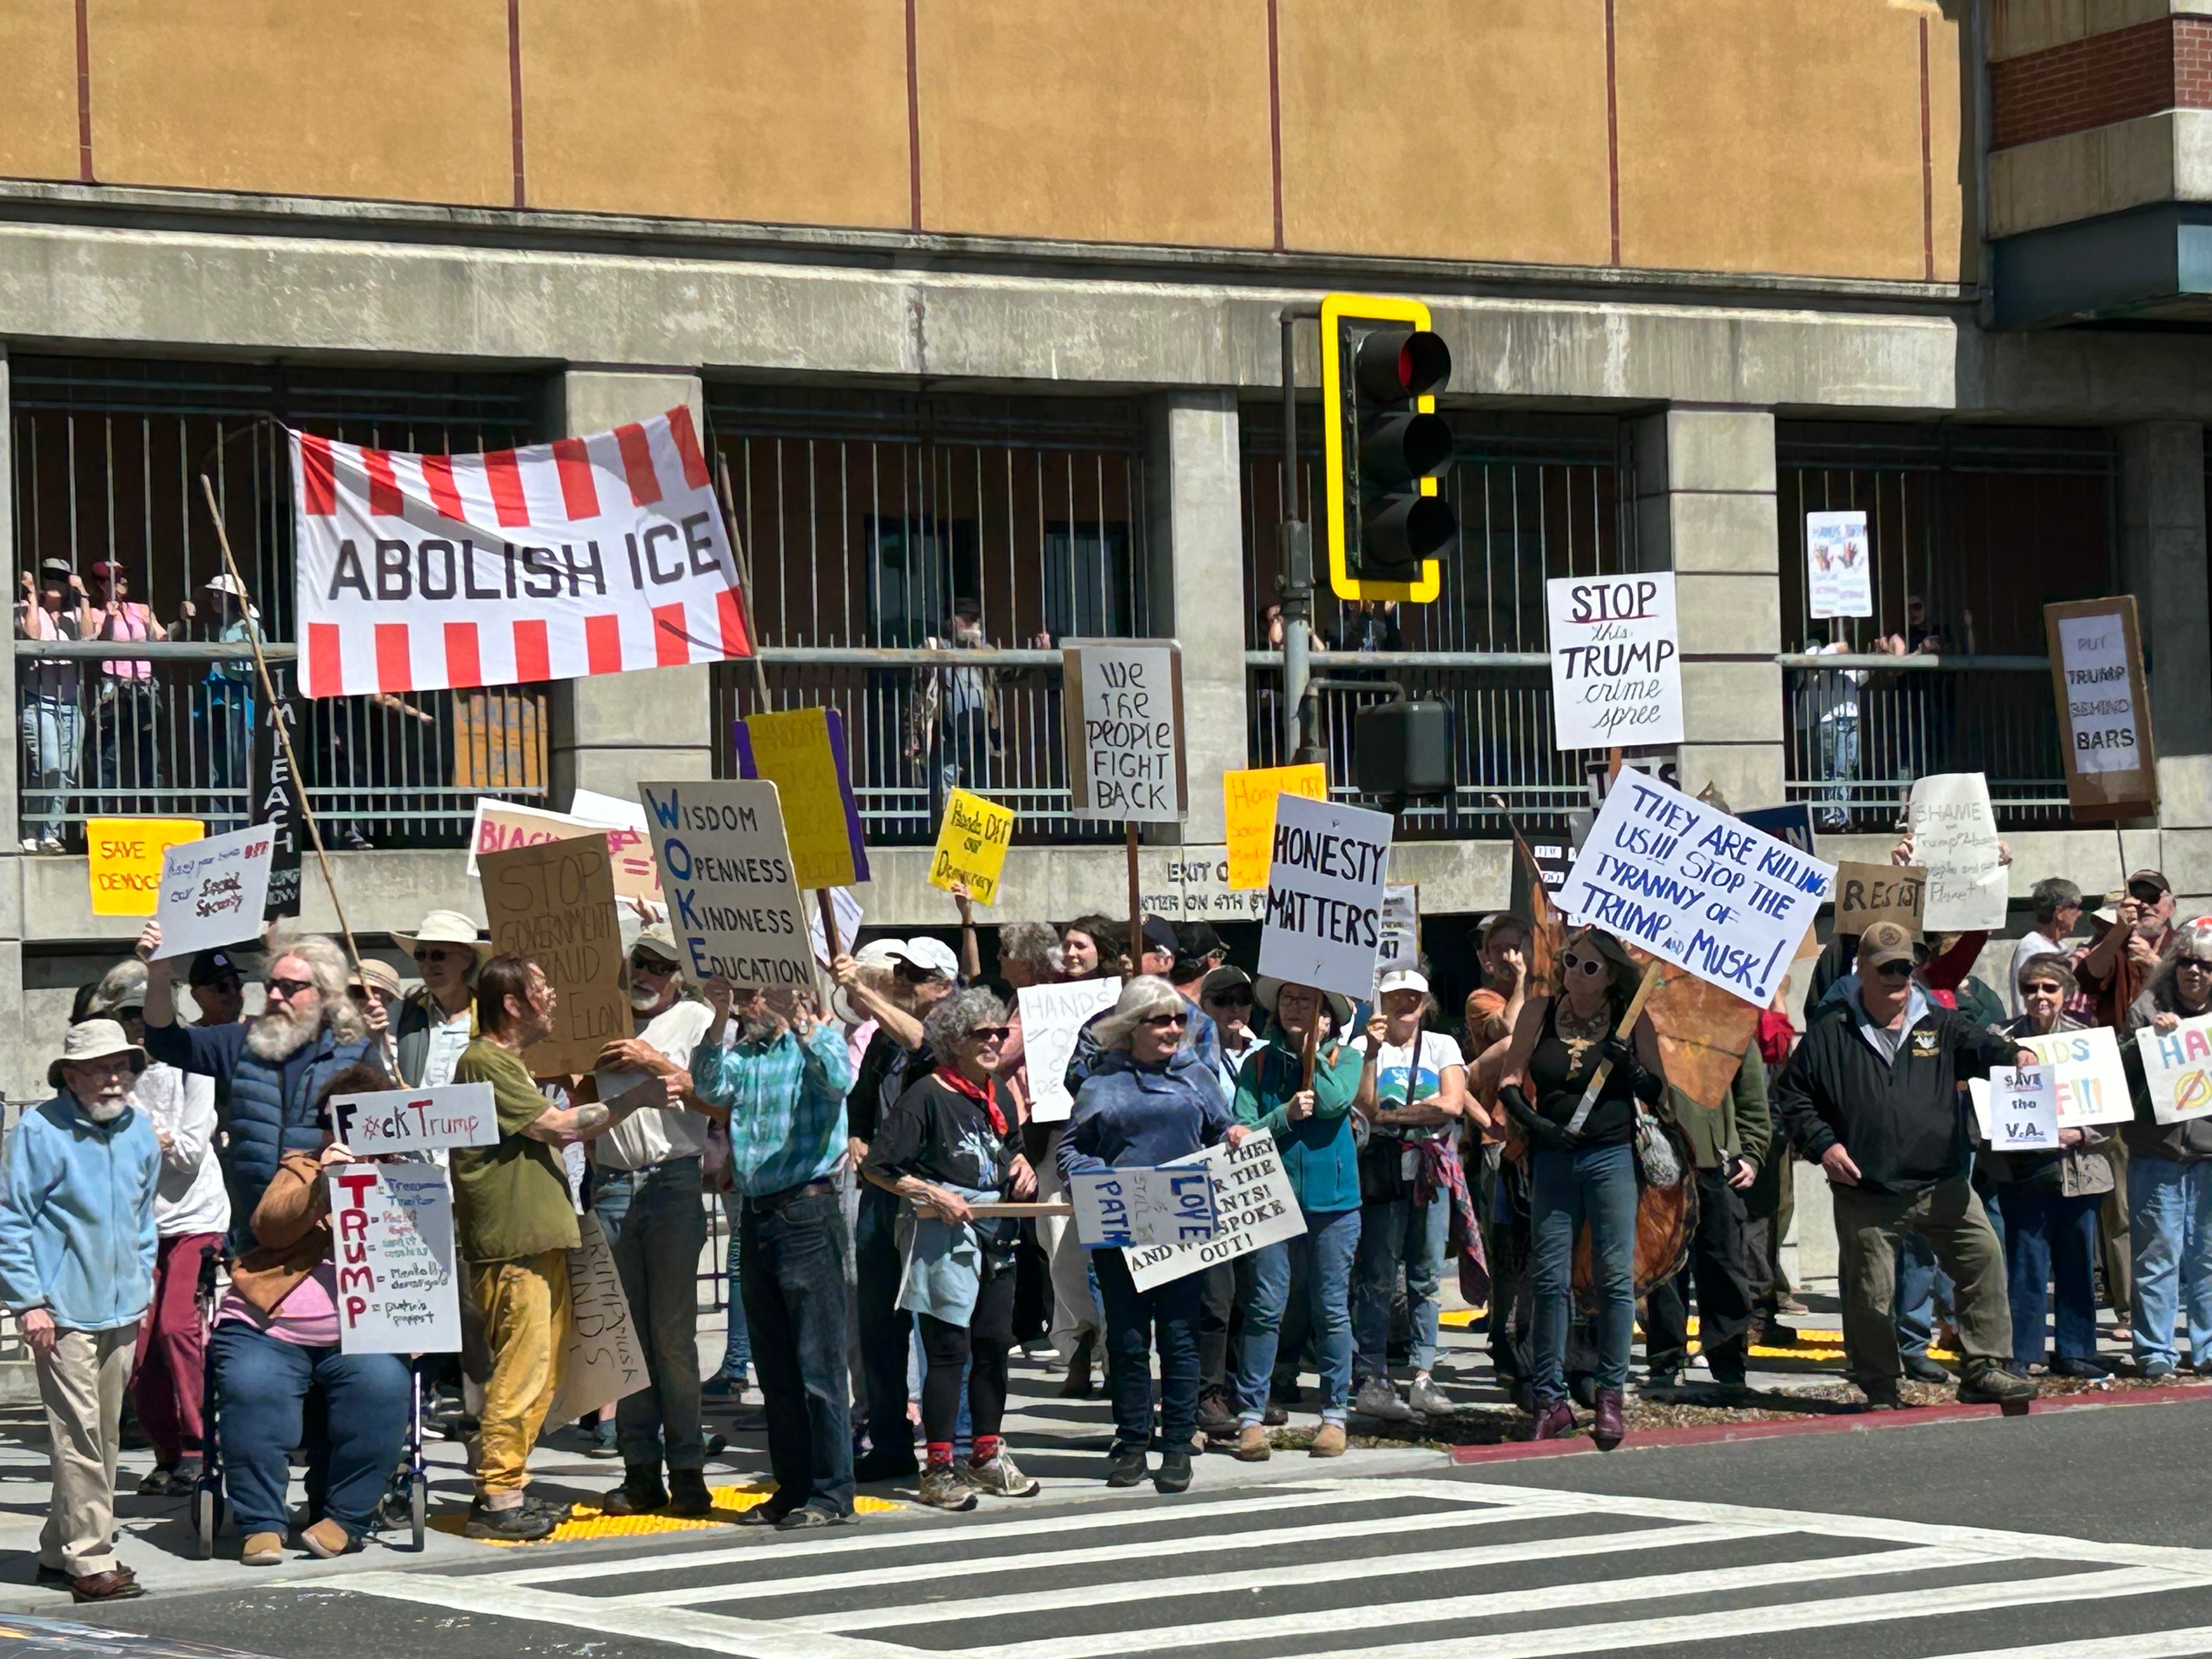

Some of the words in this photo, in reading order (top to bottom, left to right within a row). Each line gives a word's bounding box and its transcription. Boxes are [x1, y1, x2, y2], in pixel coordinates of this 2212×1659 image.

[328, 539, 607, 601] ABOLISH
[624, 511, 722, 590] ICE
[1571, 581, 1656, 621] STOP
[1590, 623, 1632, 642] this
[1559, 639, 1674, 679] TRUMP
[2067, 665, 2125, 685] TRUMP
[1576, 679, 1662, 704] crime
[1590, 704, 1662, 738] spree
[2076, 728, 2135, 751] BARS
[1093, 750, 1169, 781] FIGHT
[645, 788, 758, 832] WISDOM
[1096, 780, 1169, 817] BACK
[1915, 802, 1982, 822] SHAME
[101, 841, 145, 860] SAVE
[664, 838, 788, 883] OPENNESS
[1272, 824, 1386, 885] HONESTY
[1632, 785, 1700, 837] THEY
[1698, 825, 1757, 866] ARE
[1757, 846, 1830, 898] KILLING
[498, 851, 603, 912] STOP
[1167, 861, 1211, 882] EXIT
[1596, 852, 1705, 911] TYRANNY
[1706, 901, 1741, 924] OF
[1680, 851, 1745, 894] STOP
[1747, 881, 1796, 921] THE
[674, 888, 794, 934] KINDNESS
[1186, 894, 1208, 911] ON
[1264, 884, 1379, 949] MATTERS
[499, 901, 617, 953] GOVERNMENT
[1581, 881, 1673, 943] TRUMP
[1682, 929, 1786, 998] MUSK!
[687, 936, 810, 985] EDUCATION
[407, 1099, 479, 1143] Trump
[1231, 1159, 1276, 1185] THE
[1094, 1181, 1131, 1242] PATH
[1170, 1175, 1212, 1241] LOVE
[1130, 1244, 1173, 1272] AND
[1200, 1233, 1253, 1262] OUT!
